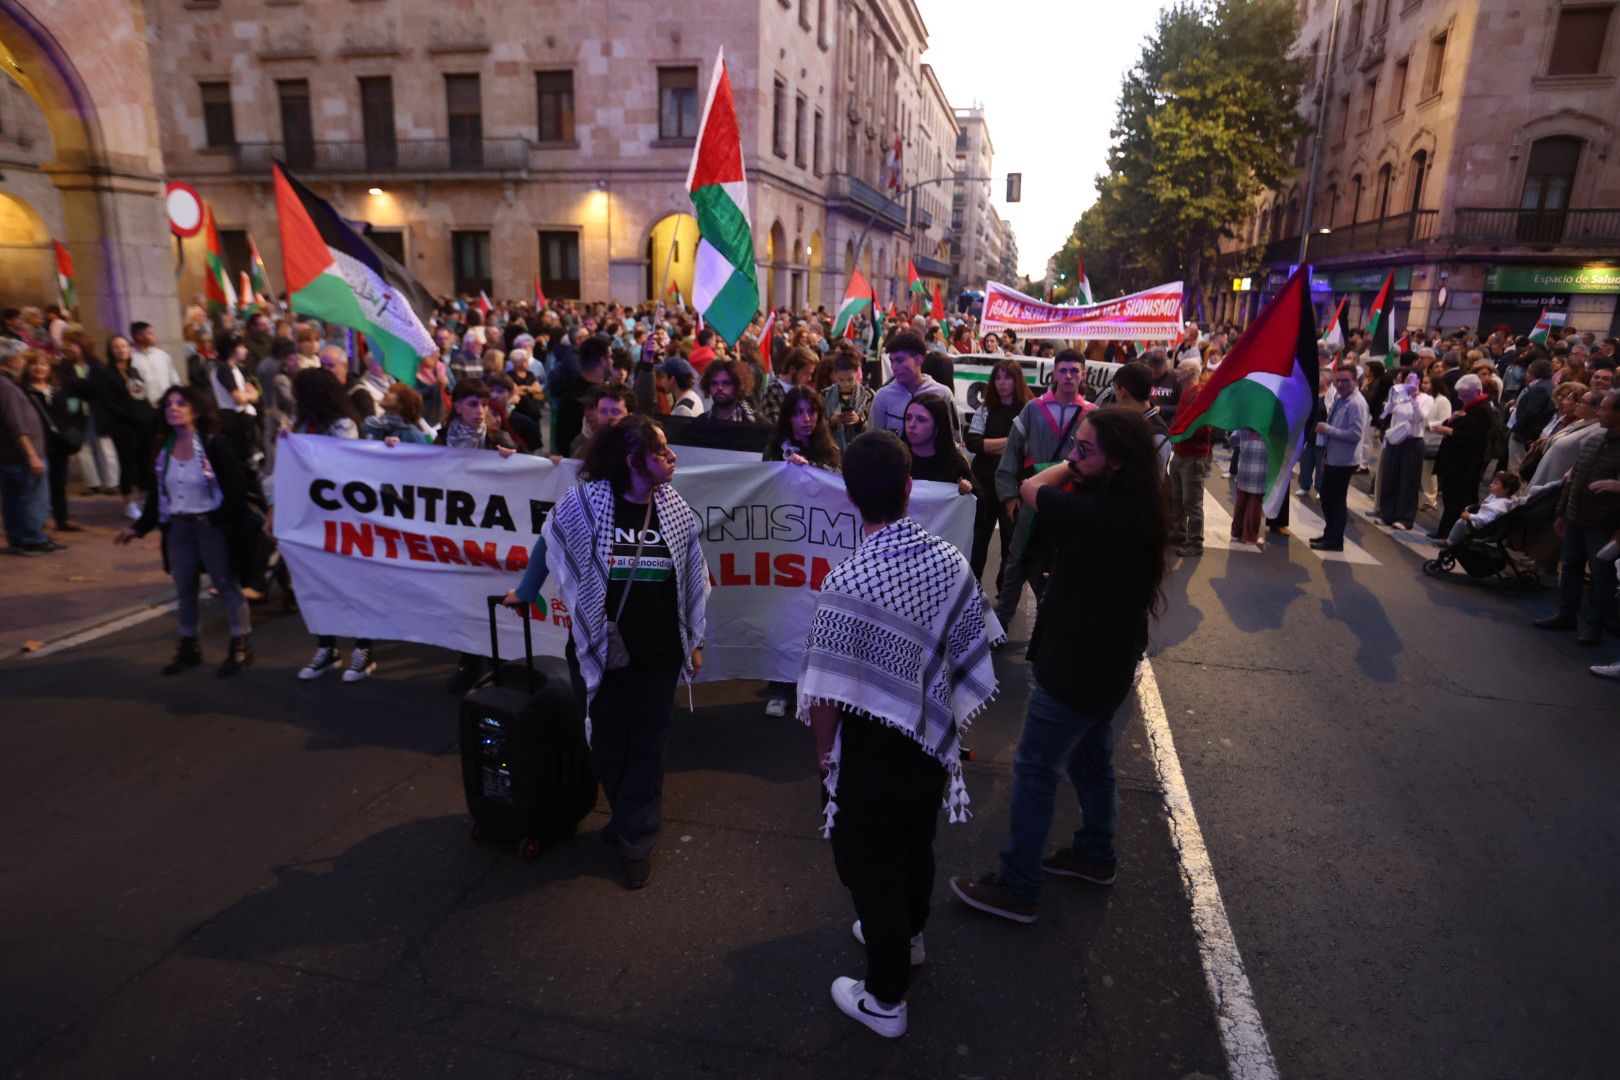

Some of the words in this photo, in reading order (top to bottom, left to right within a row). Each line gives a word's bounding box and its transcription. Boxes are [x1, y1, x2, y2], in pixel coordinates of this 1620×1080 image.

[1534, 274, 1573, 285] Espacio
[1575, 273, 1589, 284] de
[990, 299, 1020, 318] ¡GAZA
[1124, 298, 1181, 317] SIONISMO!
[309, 478, 517, 532] CONTRA
[530, 499, 556, 534] E
[323, 520, 529, 571] INTERNA
[615, 527, 661, 545] NO
[617, 558, 626, 566] al
[628, 558, 671, 568] Gnocidio
